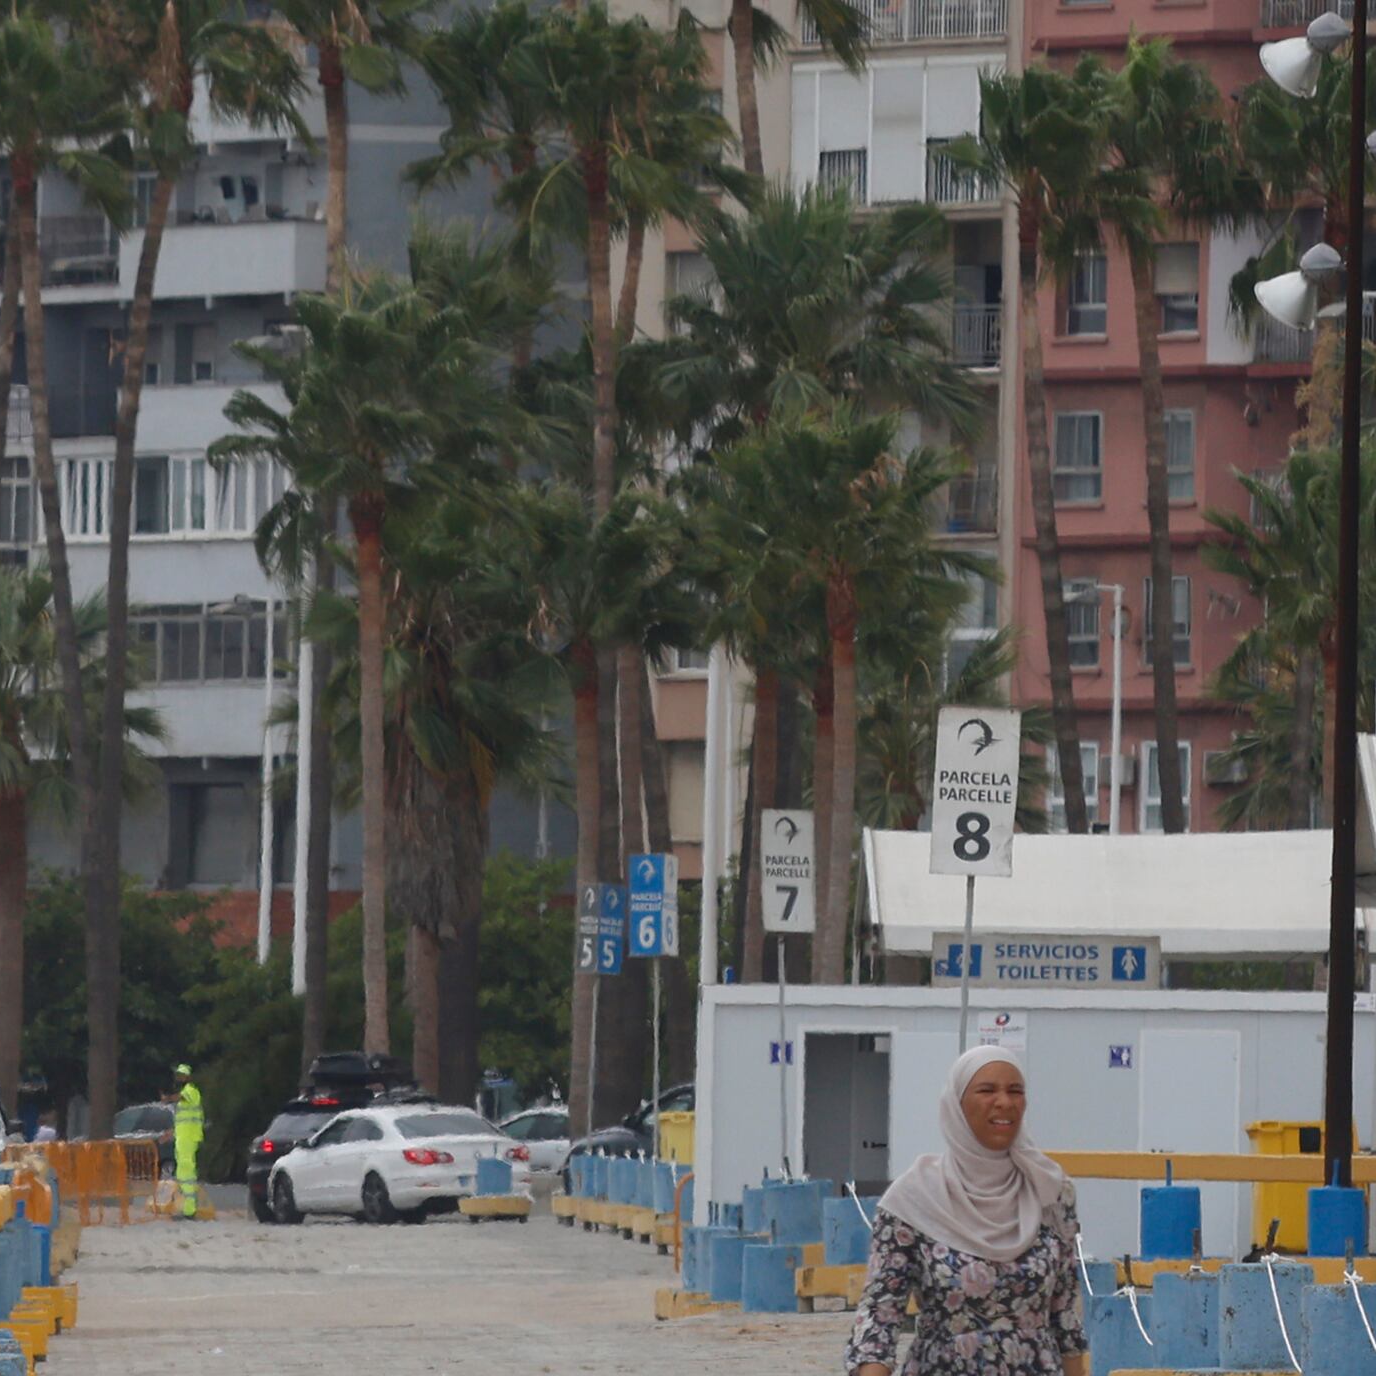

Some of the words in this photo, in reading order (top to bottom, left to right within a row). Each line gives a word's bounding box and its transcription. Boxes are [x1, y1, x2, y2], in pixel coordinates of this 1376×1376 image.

[940, 771, 1011, 786] PARCELA
[939, 787, 1012, 804] PARCELLE
[953, 811, 991, 862] 8
[765, 855, 810, 866] PARCELA
[765, 867, 810, 879] PARCELLE
[775, 885, 798, 921] 7
[639, 915, 656, 949] 6
[580, 937, 592, 968] 5
[602, 940, 616, 969] 5
[995, 944, 1099, 960] SERVICIOS
[996, 965, 1098, 981] TOILETTES
